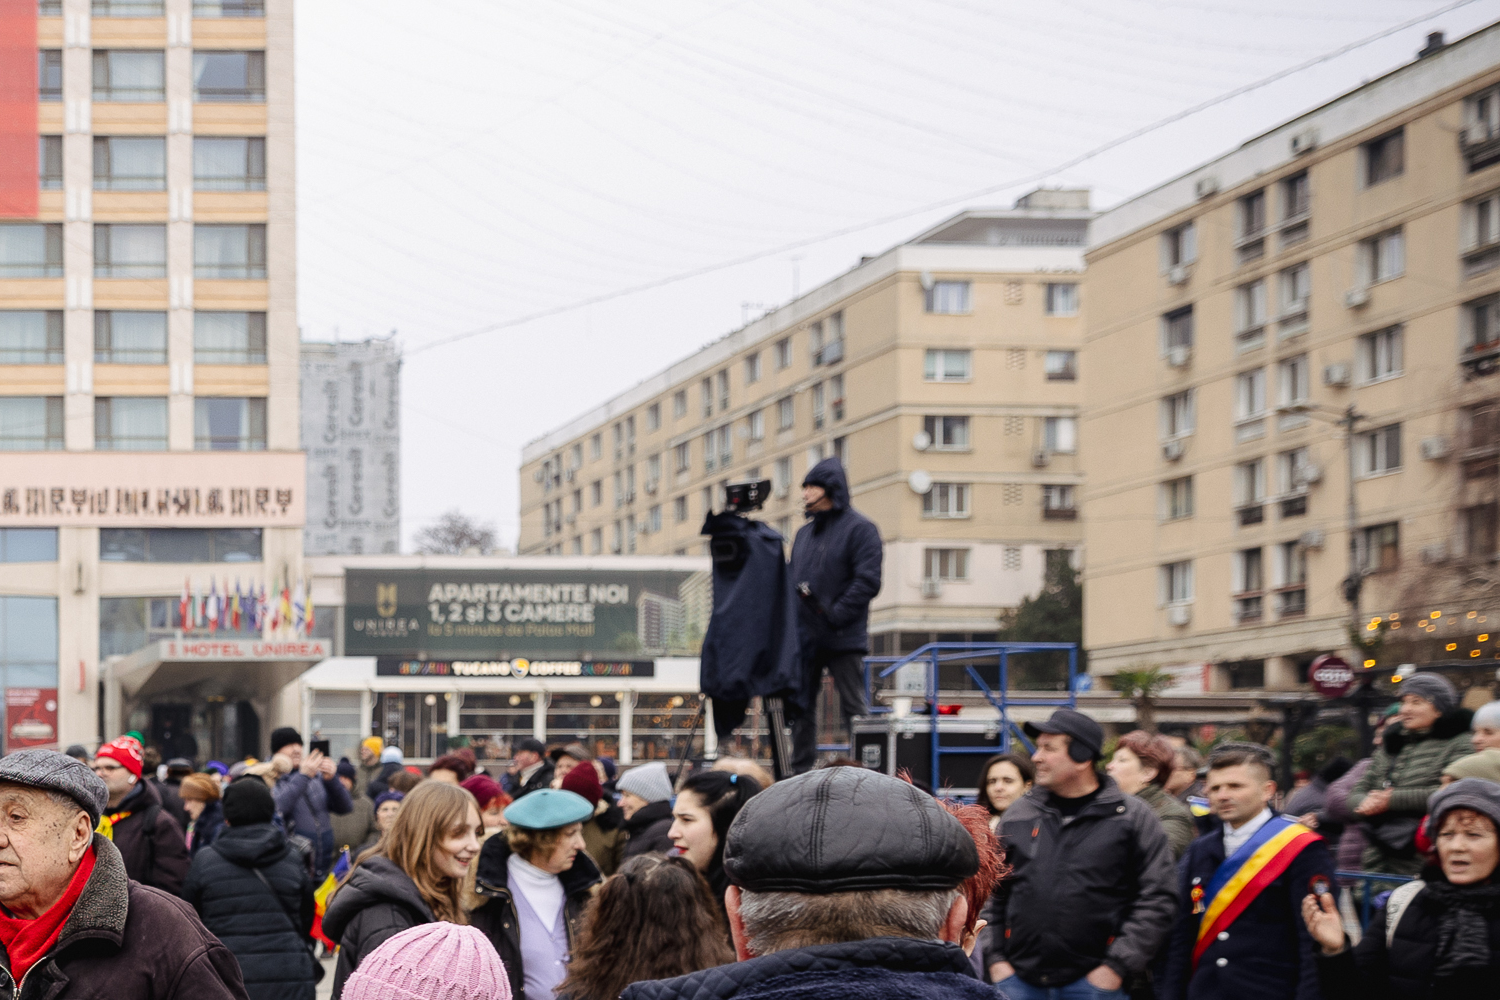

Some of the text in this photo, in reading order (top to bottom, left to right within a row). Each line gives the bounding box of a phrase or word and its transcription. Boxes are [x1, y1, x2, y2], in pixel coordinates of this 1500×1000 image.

[428, 583, 629, 604] APARTAMENTE NOI
[428, 602, 446, 624] 1,
[448, 603, 463, 622] 2
[486, 603, 503, 622] 3
[504, 603, 596, 623] CAMERE
[353, 618, 420, 632] UNIREA
[182, 642, 324, 657] HOTEL UNIREA
[451, 660, 582, 676] TUCANO COFFEE
